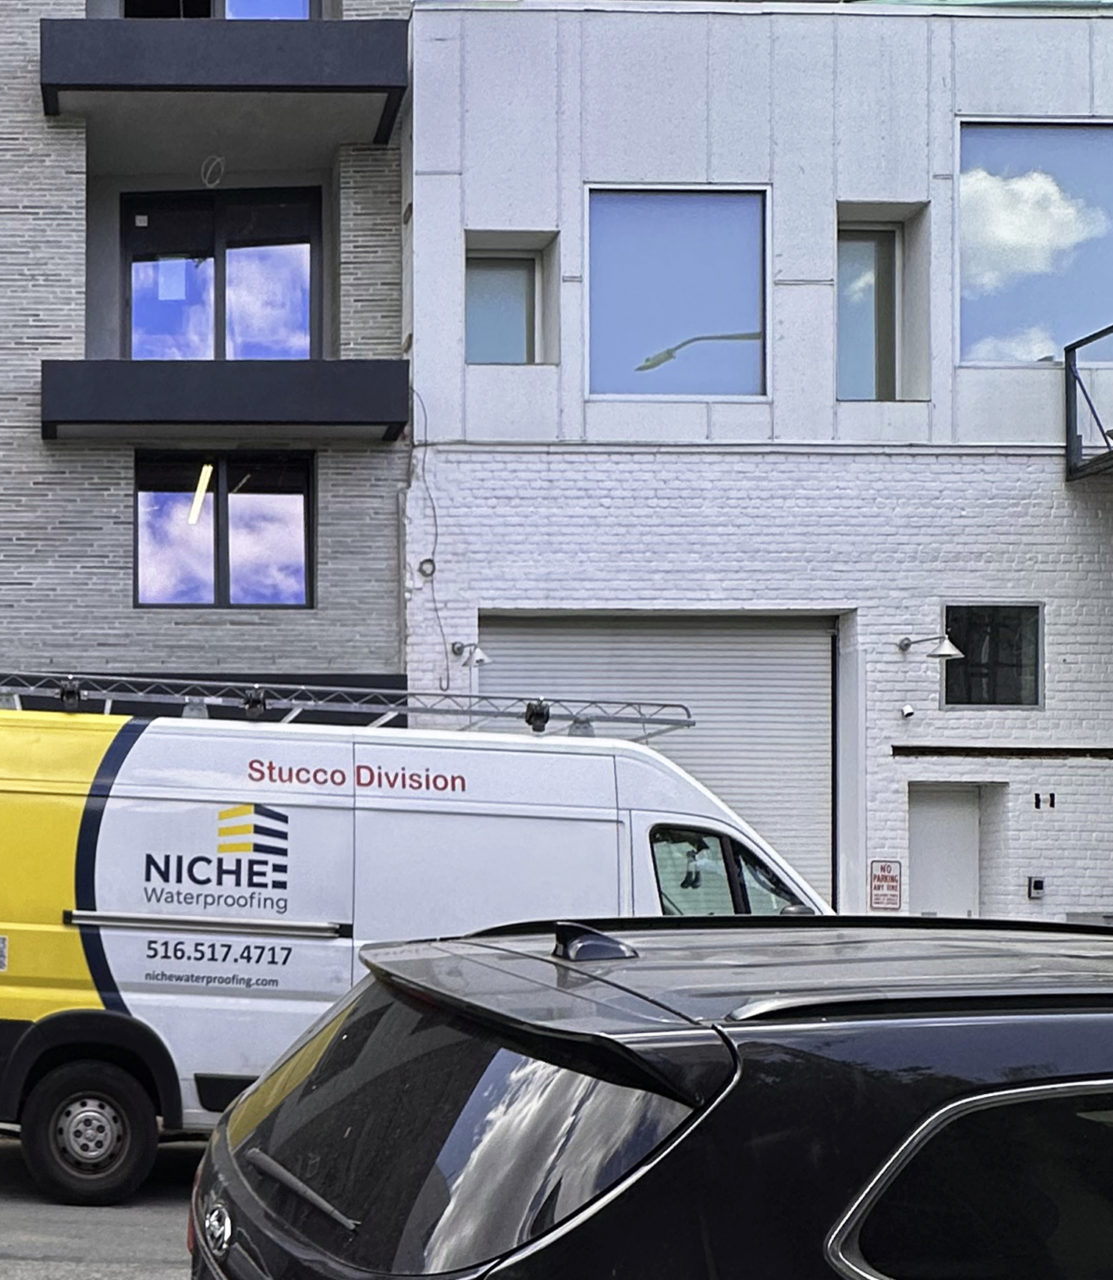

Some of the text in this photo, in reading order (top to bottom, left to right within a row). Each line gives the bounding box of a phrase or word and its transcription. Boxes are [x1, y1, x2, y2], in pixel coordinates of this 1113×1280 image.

[248, 759, 466, 792] Stucco Division
[145, 853, 268, 889] NICHE
[873, 873, 898, 882] PARKING
[880, 864, 892, 874] NO
[144, 887, 288, 914] Waterproofing
[146, 940, 293, 966] 516.517.4717
[144, 971, 279, 989] nichewaterproofing.com
